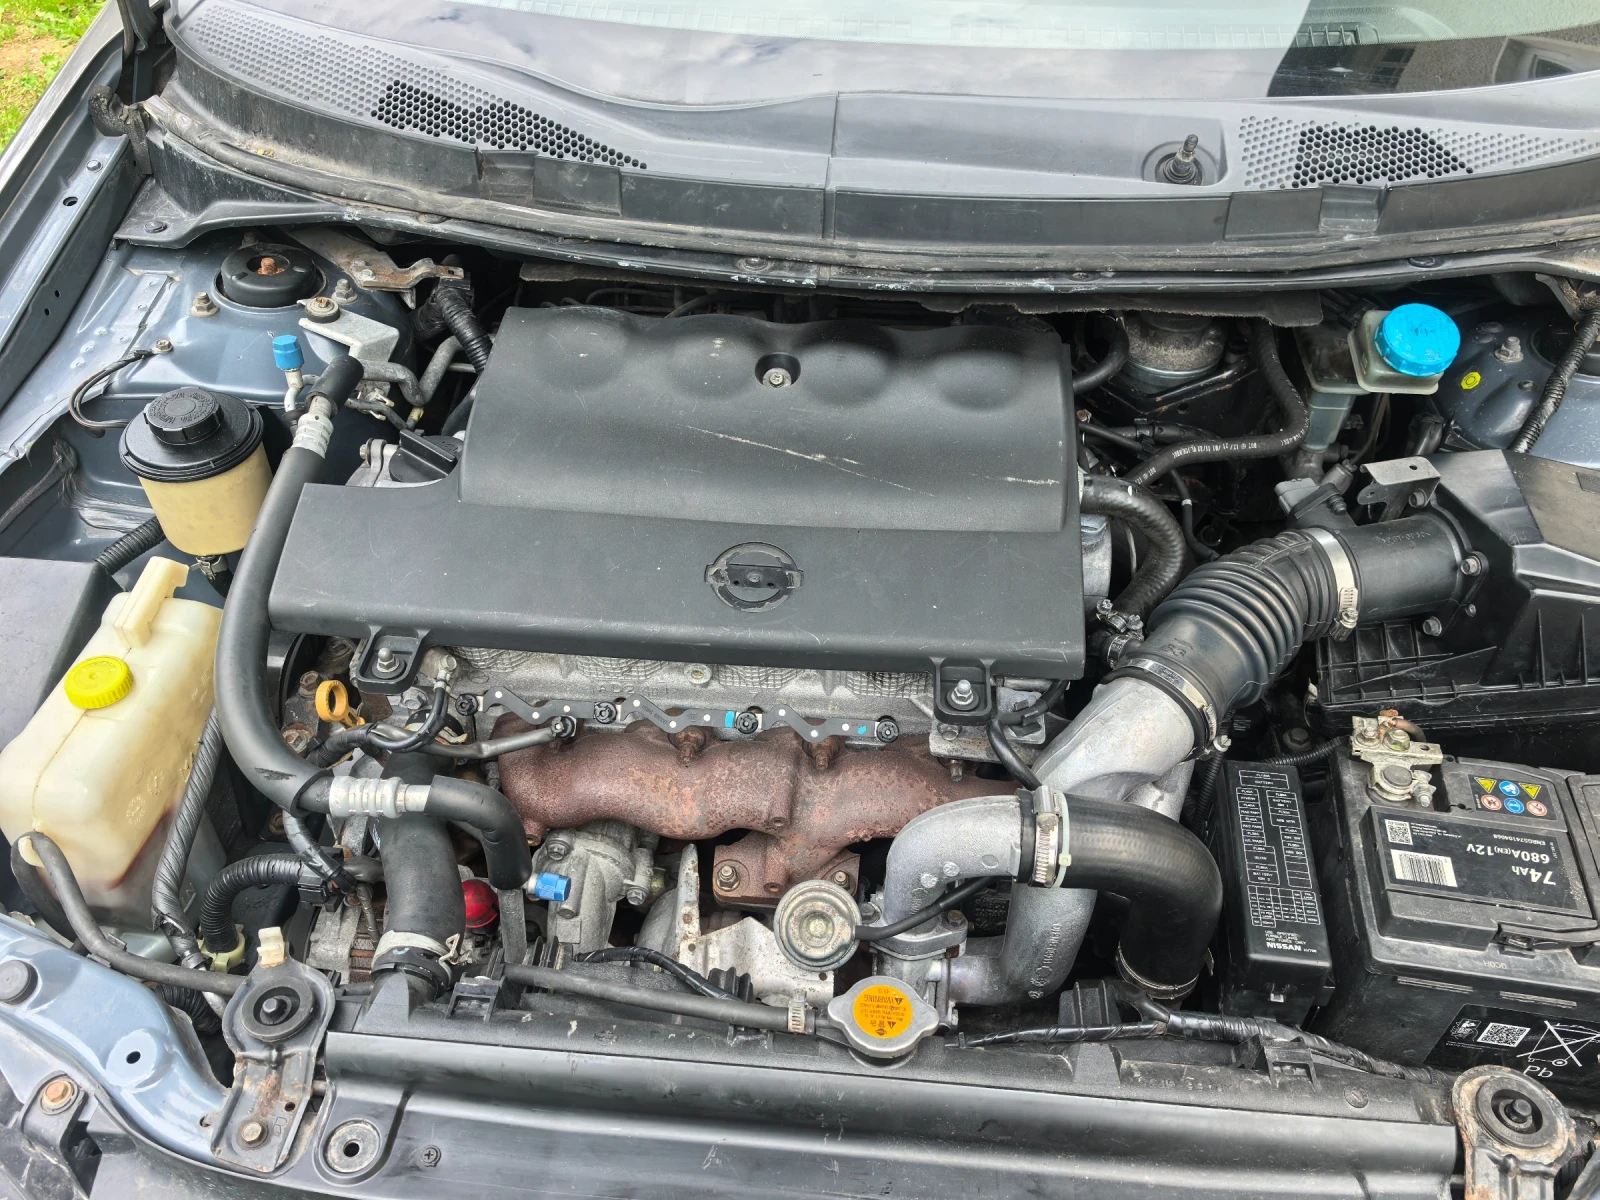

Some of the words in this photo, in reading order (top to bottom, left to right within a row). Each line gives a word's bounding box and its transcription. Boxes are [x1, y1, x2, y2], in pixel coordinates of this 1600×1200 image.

[1511, 865, 1556, 886] 74Ah
[1266, 942, 1302, 951] NISSAN
[863, 994, 894, 1004] WARNING
[1523, 1065, 1553, 1078] Pb
